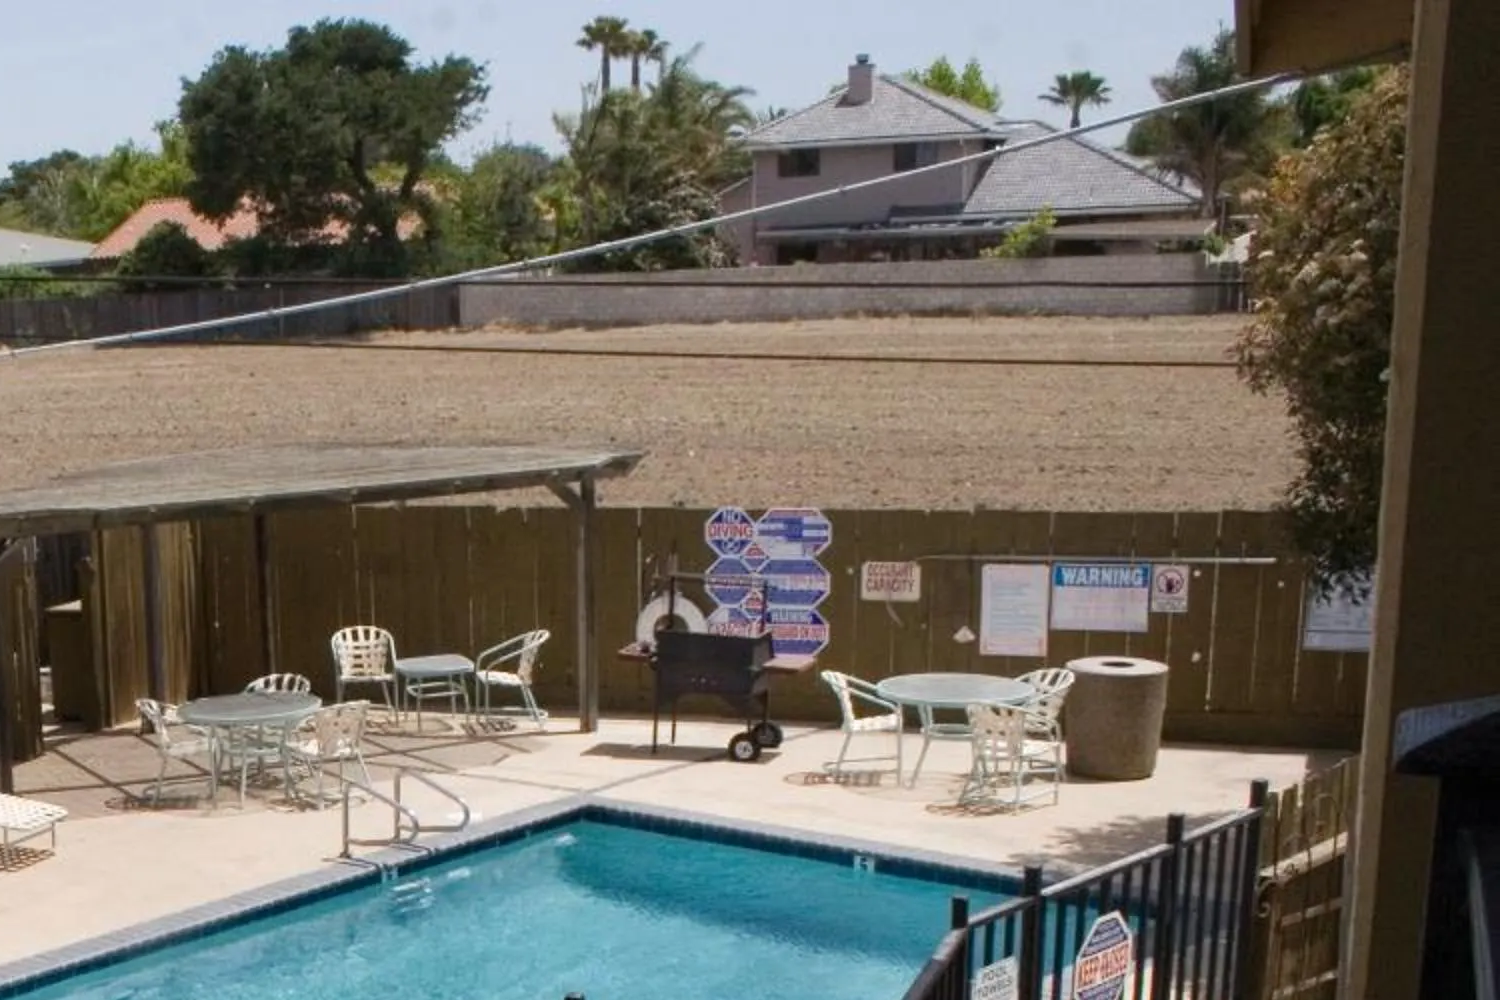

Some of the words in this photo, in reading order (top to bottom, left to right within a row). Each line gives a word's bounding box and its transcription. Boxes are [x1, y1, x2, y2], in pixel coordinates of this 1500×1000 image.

[722, 510, 740, 523] NO
[708, 524, 752, 538] DIVING
[1061, 566, 1144, 586] WARNING
[866, 577, 915, 592] CAPACITY
